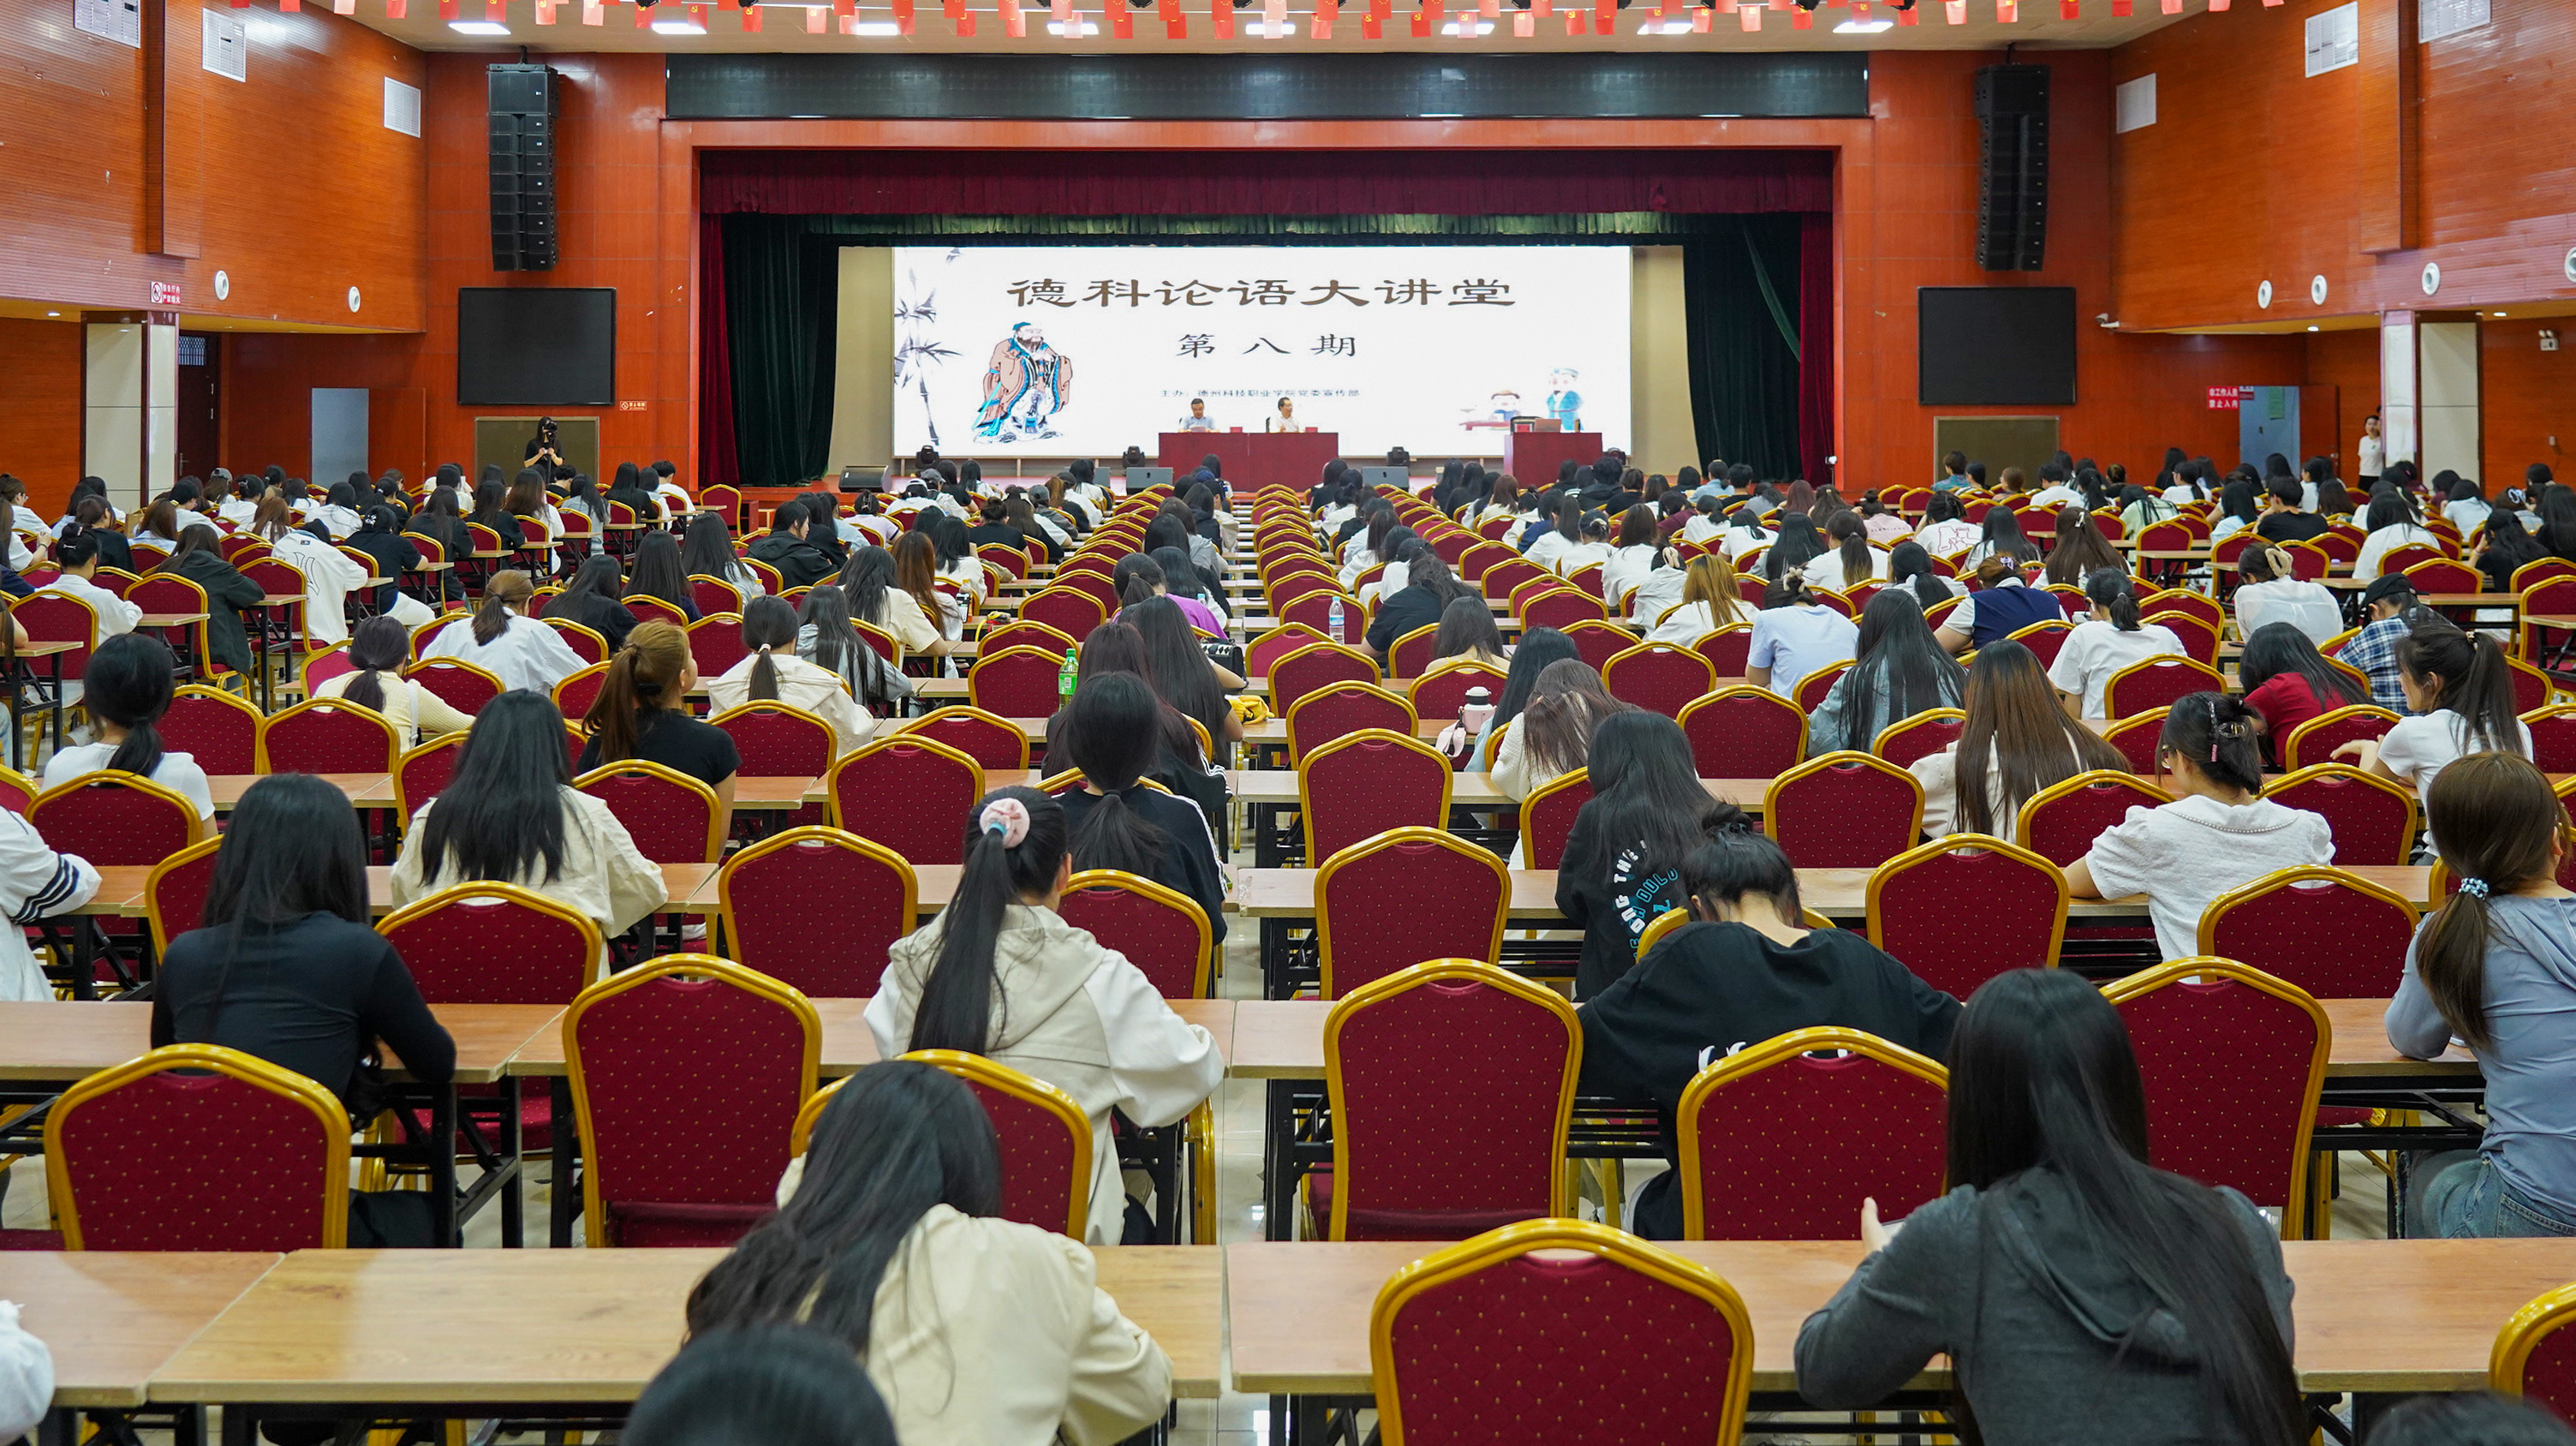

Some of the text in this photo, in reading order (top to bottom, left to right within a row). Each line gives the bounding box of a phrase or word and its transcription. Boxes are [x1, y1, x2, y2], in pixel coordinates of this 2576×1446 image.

[1006, 278, 1516, 308] 德科论语大讲堂
[1176, 333, 1357, 358] 第八期
